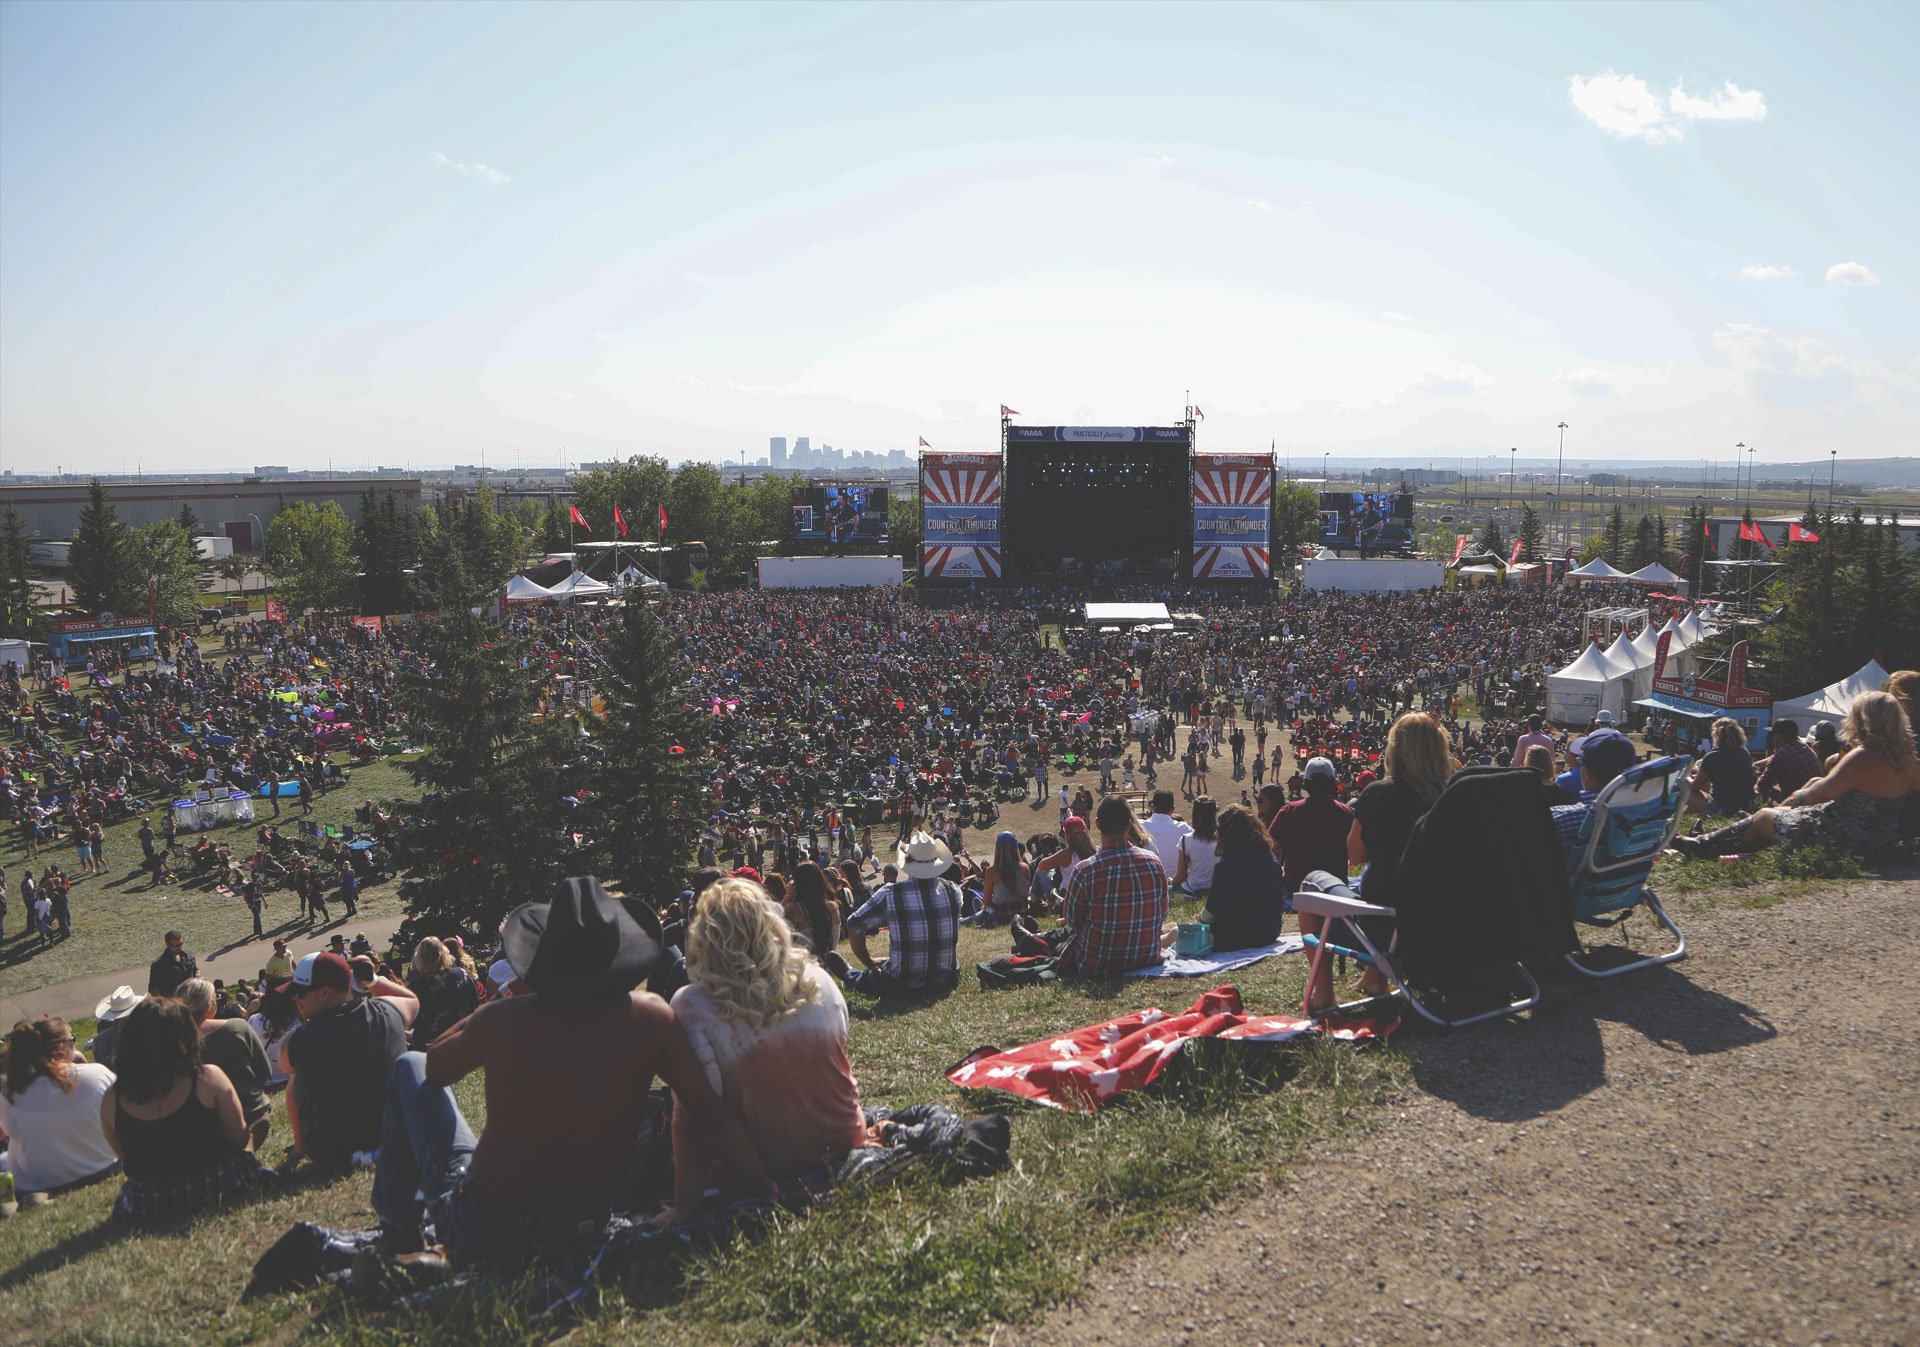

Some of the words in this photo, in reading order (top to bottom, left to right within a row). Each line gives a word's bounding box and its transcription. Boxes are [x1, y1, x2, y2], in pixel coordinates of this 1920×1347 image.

[1073, 430, 1103, 438] PRACTICALLY
[927, 518, 959, 530] COUNTRY
[966, 519, 997, 530] THUNDER
[1197, 519, 1228, 531] COUNTRY
[1236, 519, 1267, 531] THUNDER
[1655, 681, 1674, 691] TICKETS
[1658, 694, 1671, 703] FOOD
[1704, 692, 1725, 703] TICKETS
